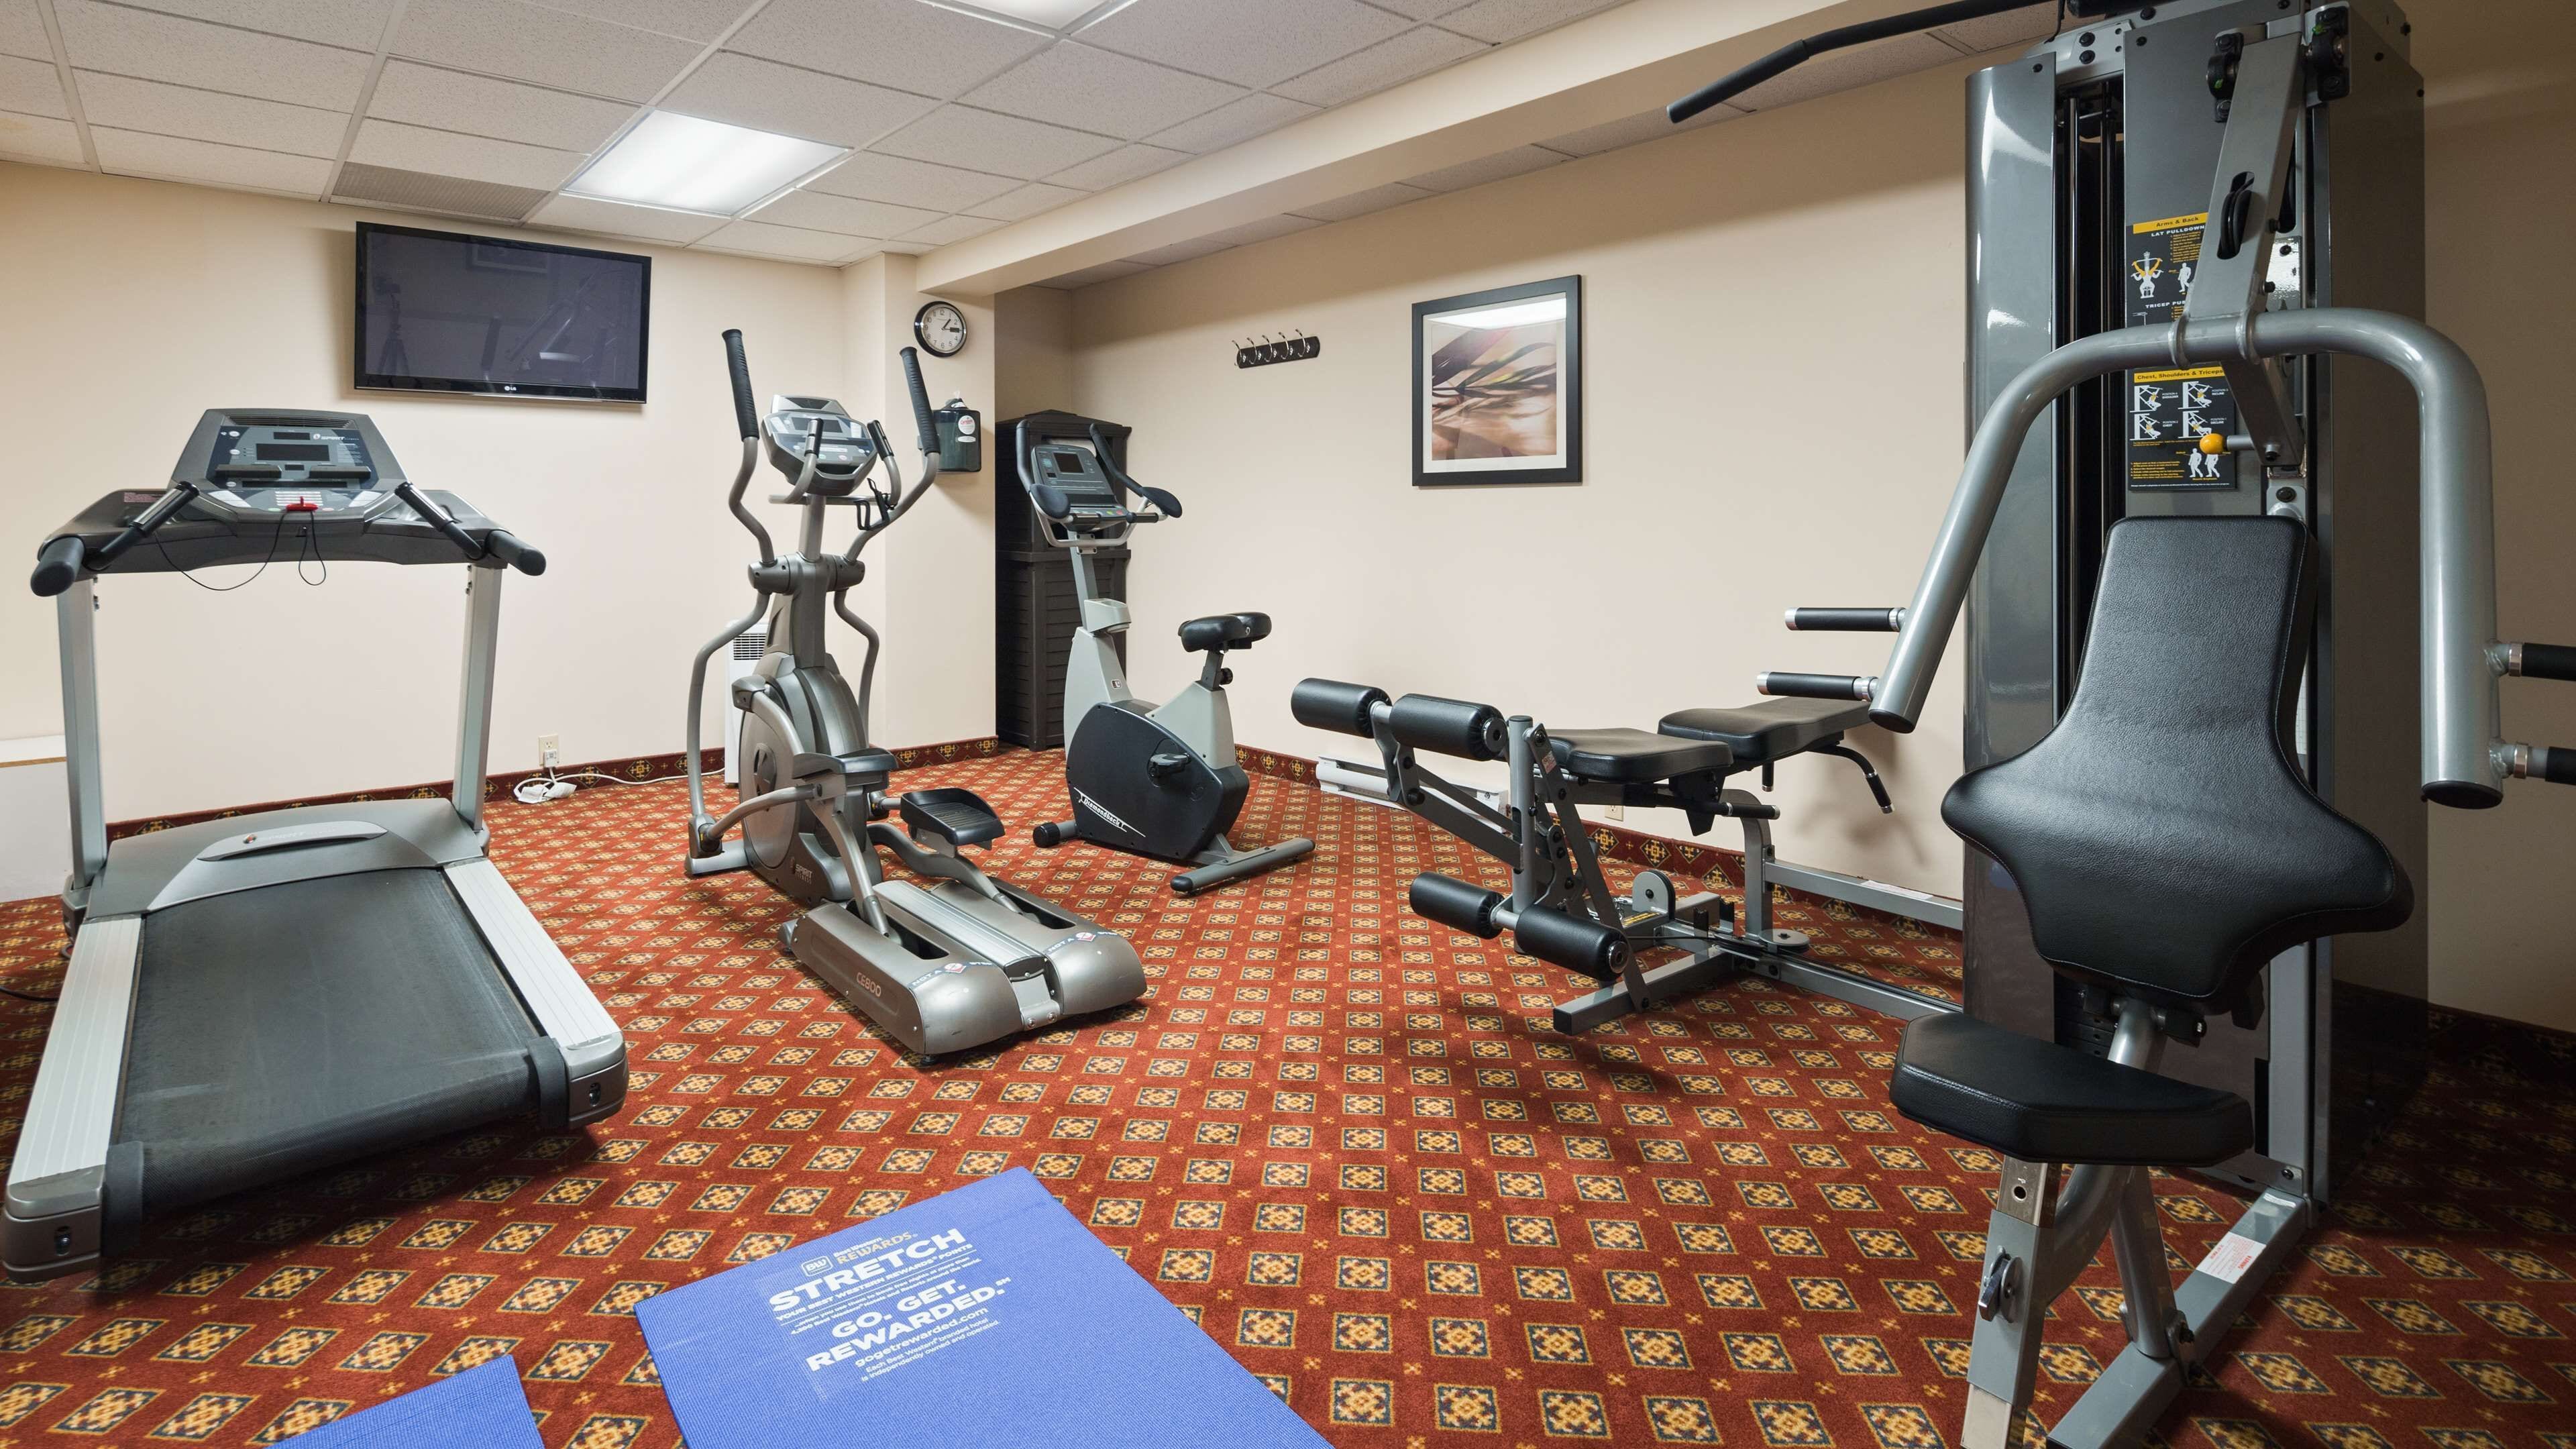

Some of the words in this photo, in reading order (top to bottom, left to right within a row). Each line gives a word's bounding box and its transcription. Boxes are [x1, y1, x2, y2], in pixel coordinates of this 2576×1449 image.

[2166, 225, 2205, 234] PULLDOWN
[1083, 798, 1122, 826] Diamondback
[856, 971, 881, 998] CE800
[938, 1243, 973, 1260] POINTS
[769, 1228, 965, 1311] STRETCH
[832, 1312, 892, 1337] GO.
[897, 1279, 966, 1311] GET.
[855, 1308, 988, 1367] gogetrewarded.com
